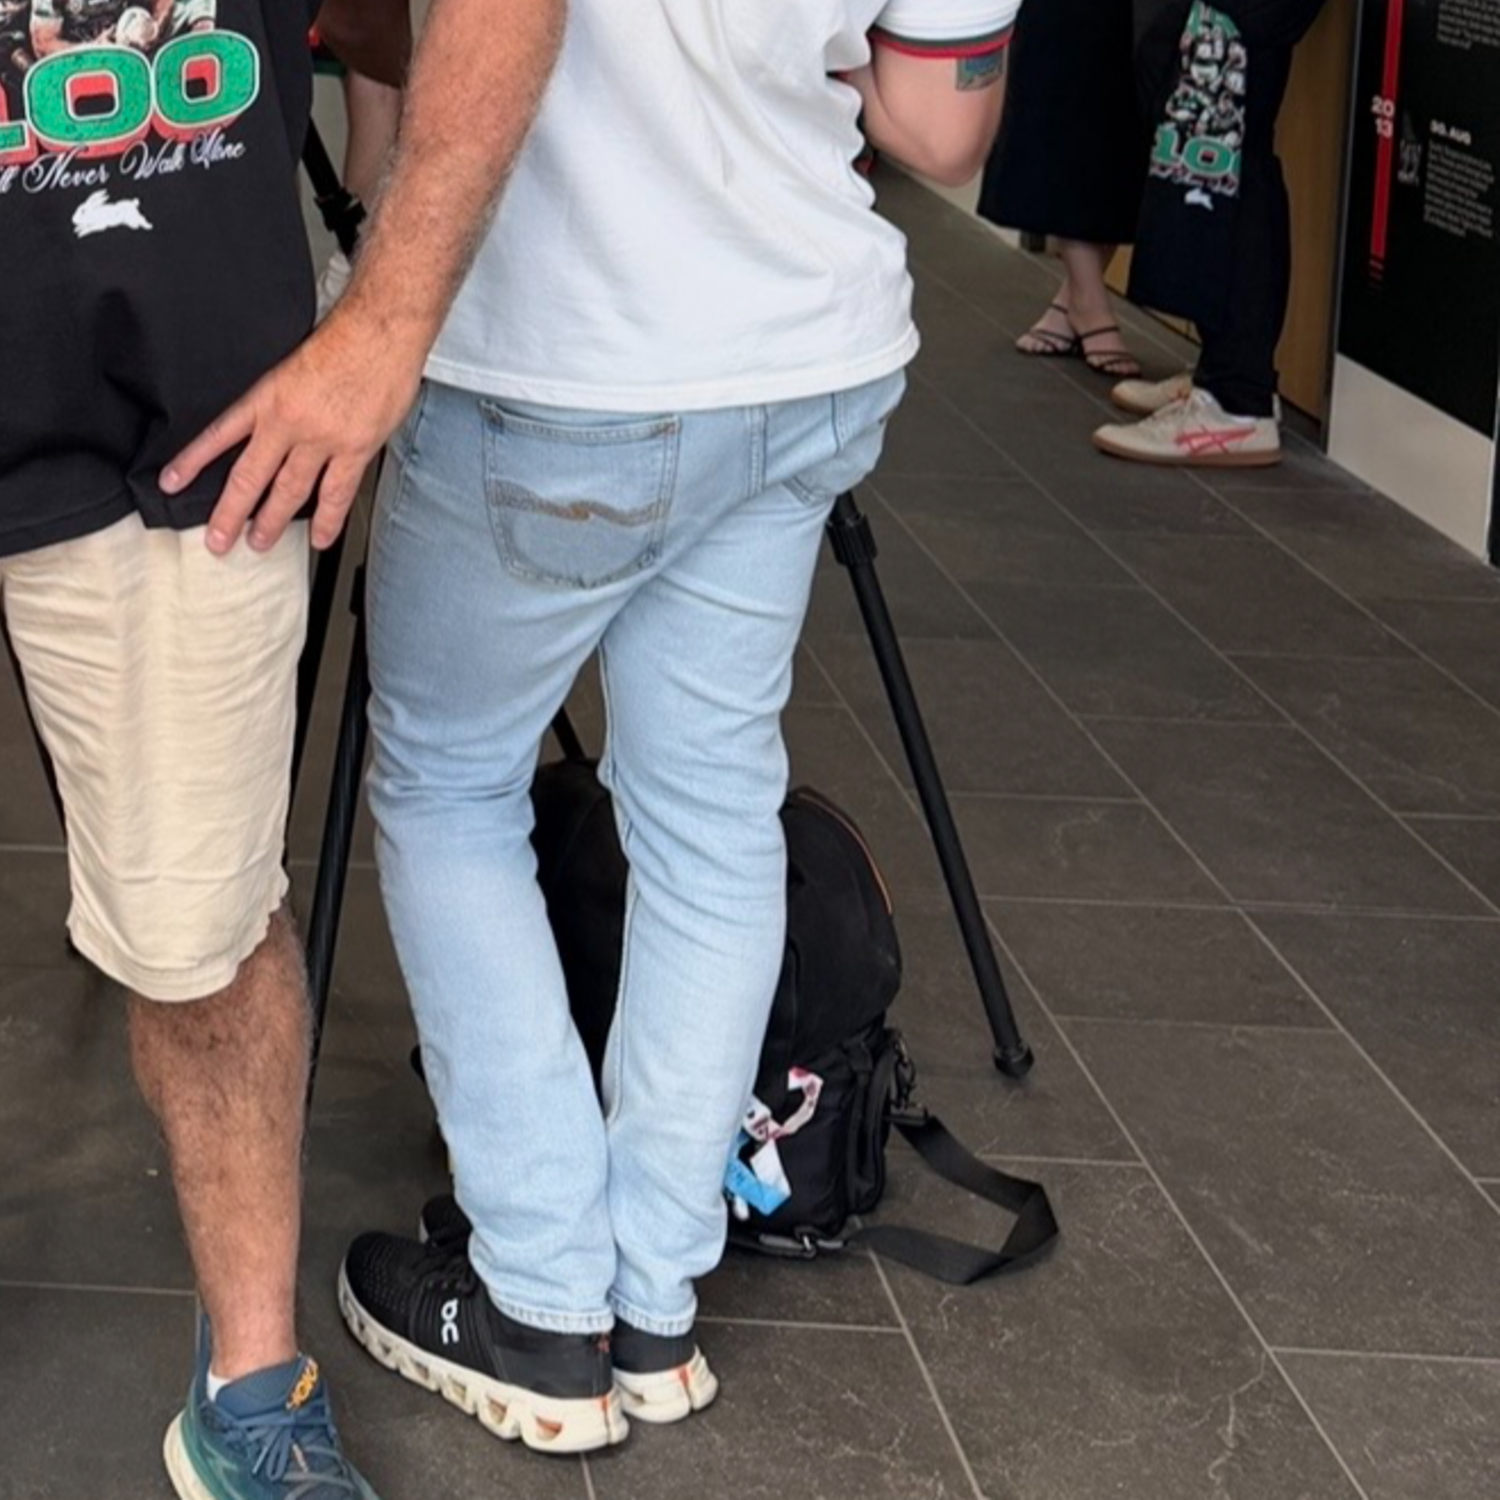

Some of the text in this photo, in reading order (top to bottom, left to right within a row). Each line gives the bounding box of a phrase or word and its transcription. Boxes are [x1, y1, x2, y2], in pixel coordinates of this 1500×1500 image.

[1372, 95, 1395, 117] 20
[22, 145, 109, 193] Never
[120, 139, 186, 181] Walk
